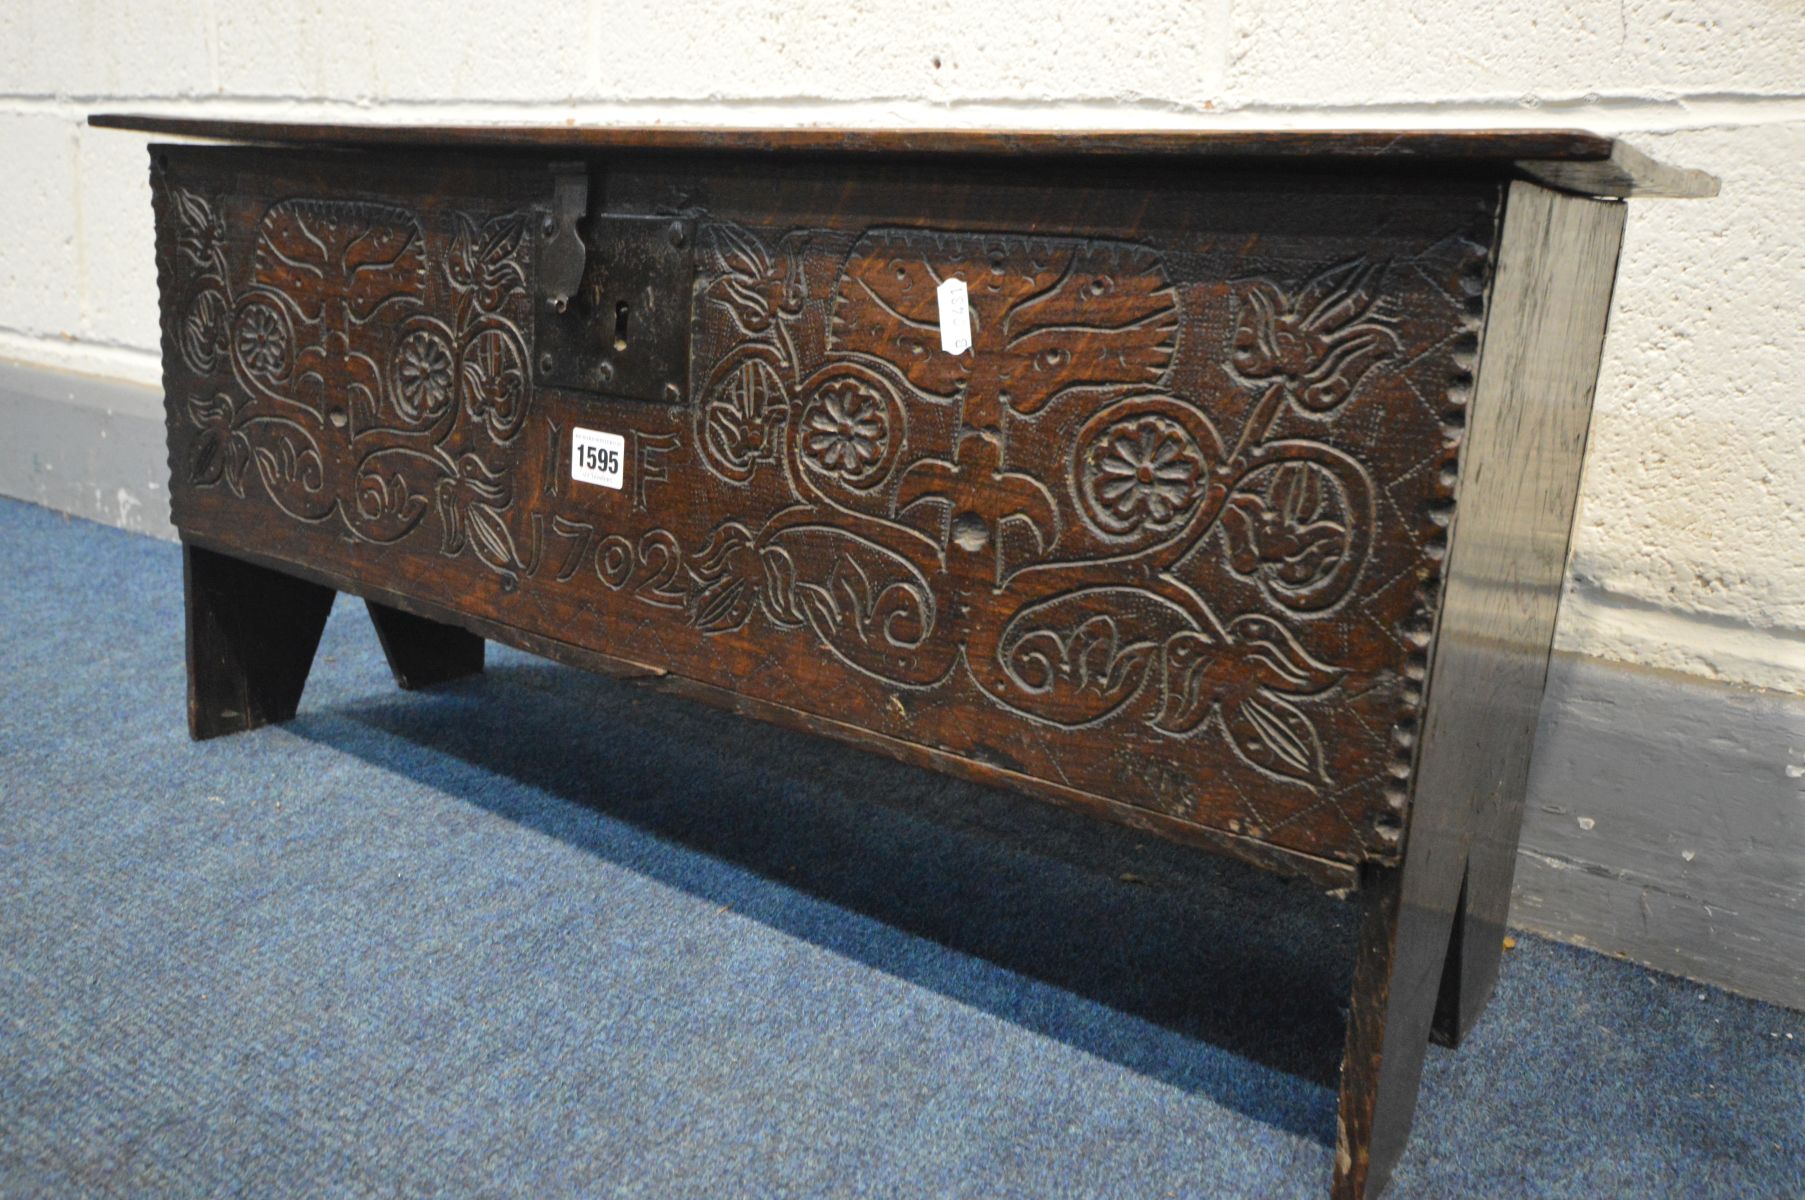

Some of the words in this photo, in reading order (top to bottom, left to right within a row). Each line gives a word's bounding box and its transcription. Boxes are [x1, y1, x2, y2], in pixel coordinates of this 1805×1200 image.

[577, 443, 619, 475] 1595
[630, 427, 681, 513] F
[525, 513, 687, 610] 1702
